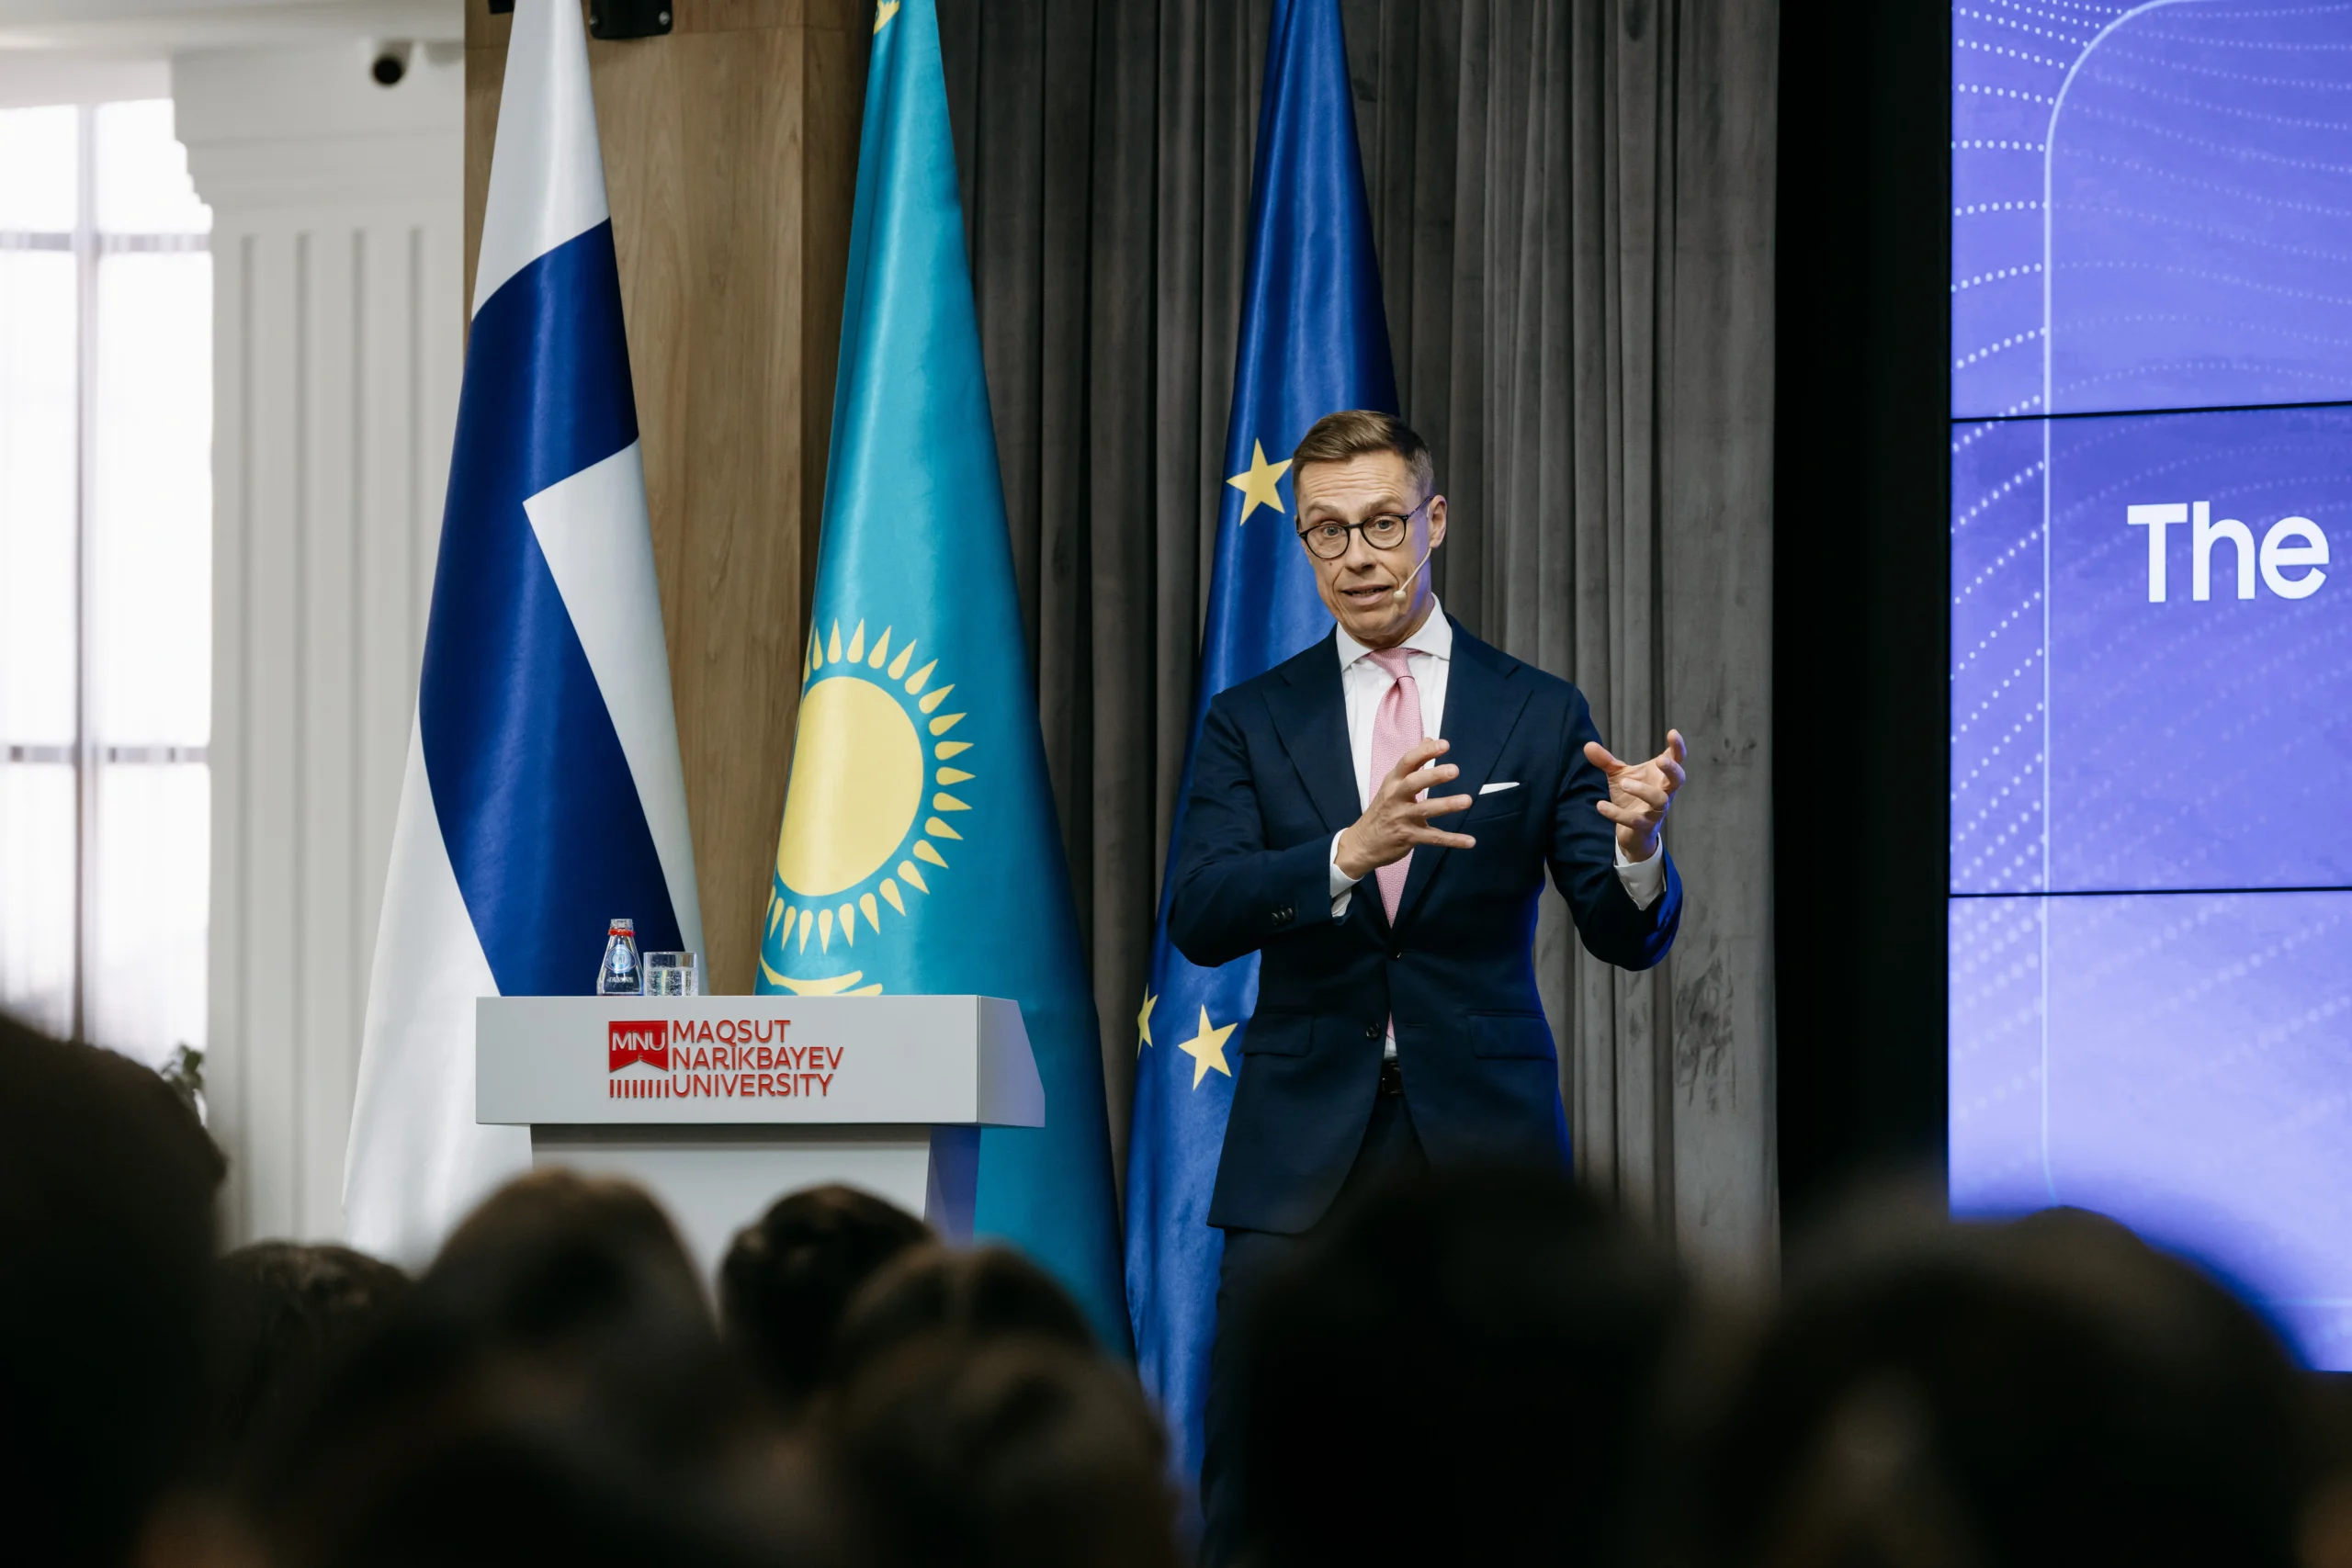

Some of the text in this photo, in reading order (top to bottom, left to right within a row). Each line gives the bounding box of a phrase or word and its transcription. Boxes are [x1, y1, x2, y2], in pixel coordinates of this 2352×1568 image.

[2127, 502, 2330, 603] The
[611, 1031, 666, 1052] MNU
[673, 1020, 791, 1046] MAQSUT
[673, 1047, 844, 1070] NARIKBAYEV
[673, 1073, 833, 1097] UNIVERSITY
